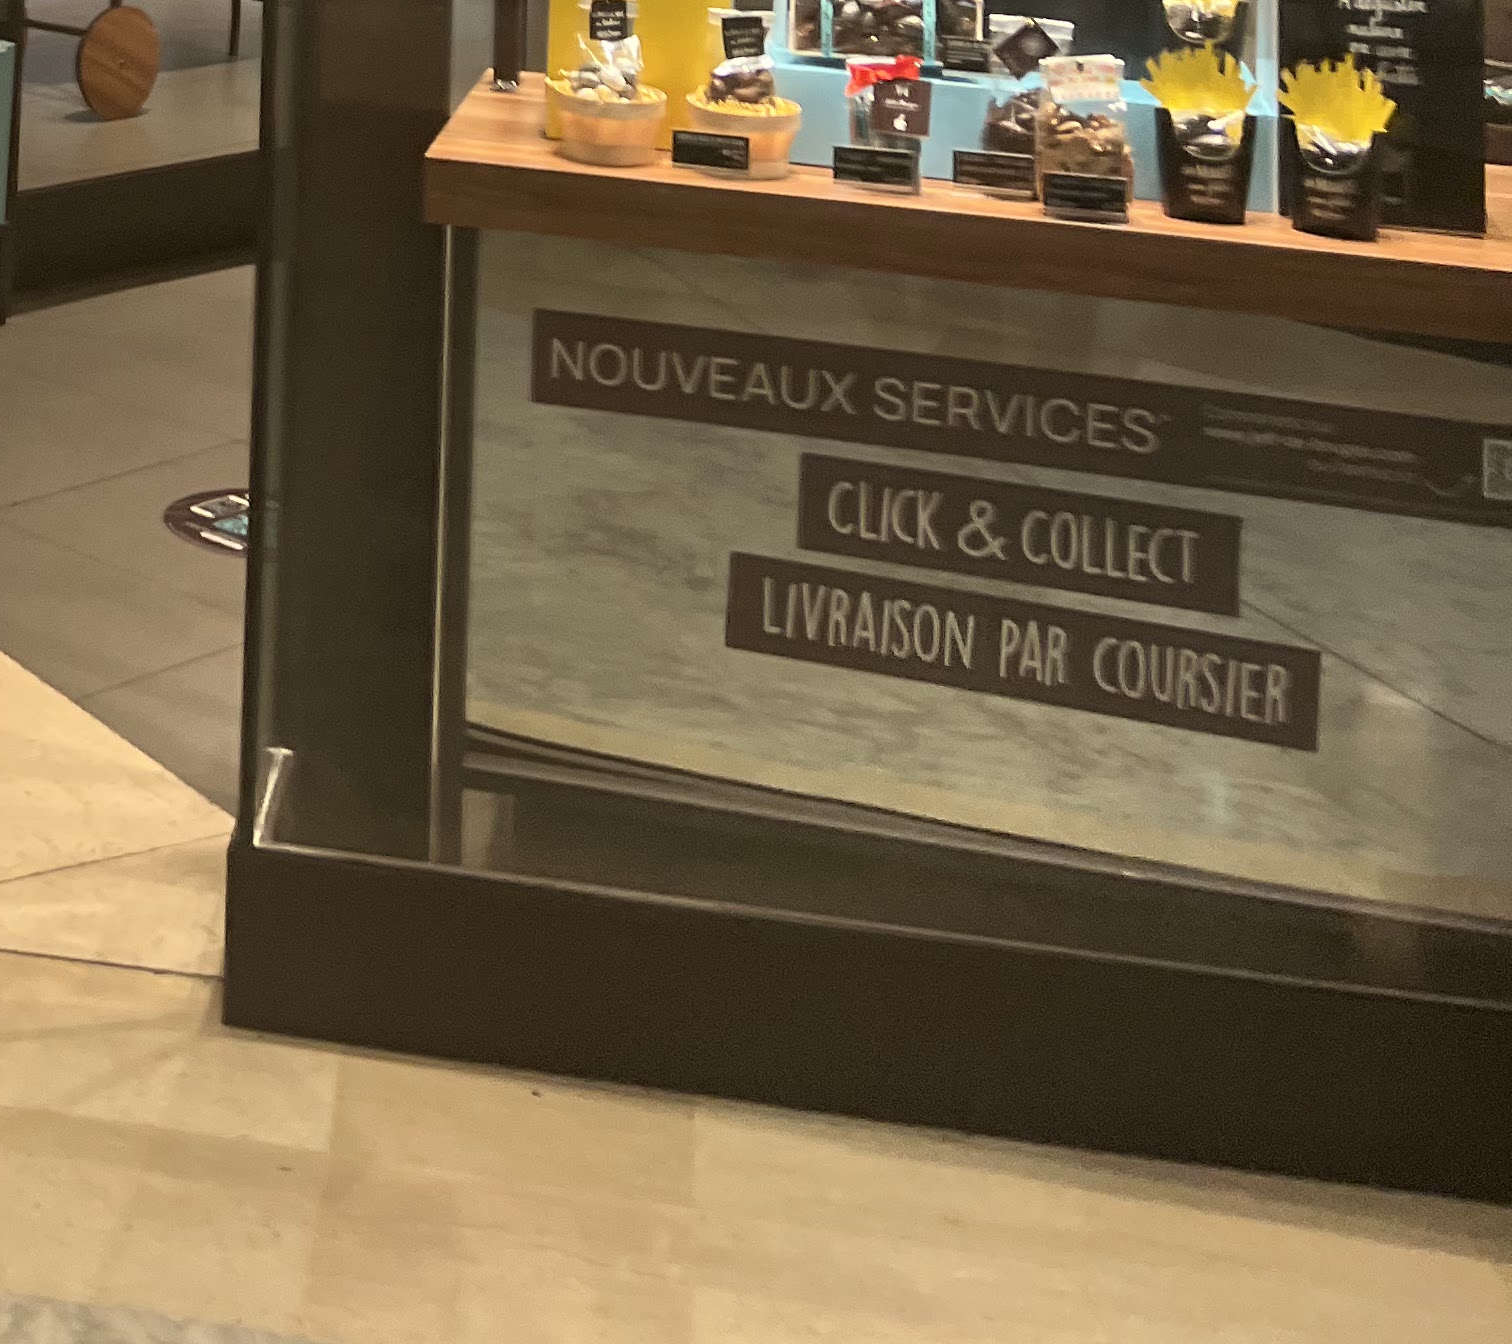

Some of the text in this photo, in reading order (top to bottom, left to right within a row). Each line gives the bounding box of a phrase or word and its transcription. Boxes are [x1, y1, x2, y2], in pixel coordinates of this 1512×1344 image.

[548, 337, 859, 415] NOUVEAUX
[827, 480, 1201, 584] CLICK & COLLECT
[760, 575, 1291, 727] LIVRAISON PAR COURSIER
